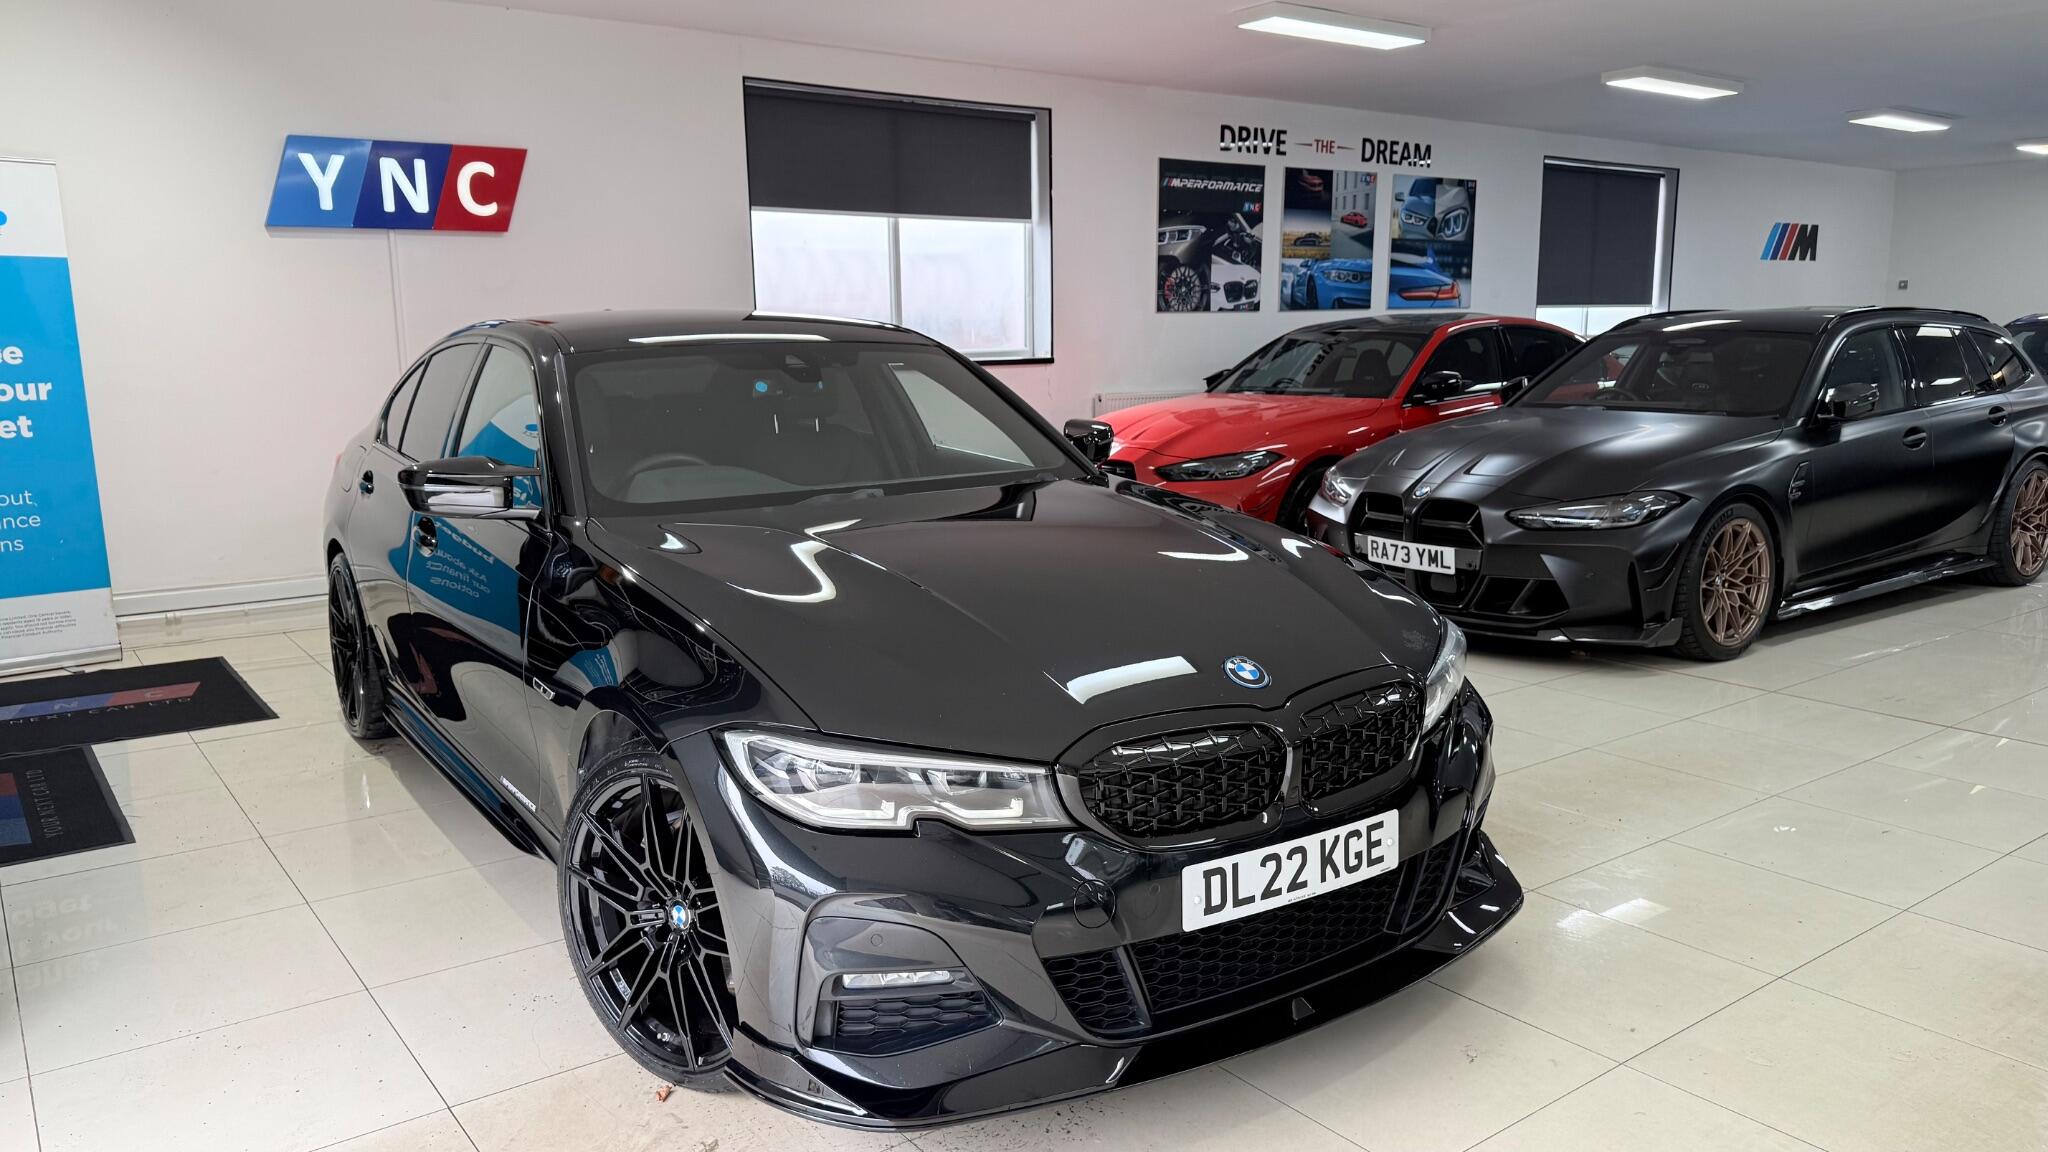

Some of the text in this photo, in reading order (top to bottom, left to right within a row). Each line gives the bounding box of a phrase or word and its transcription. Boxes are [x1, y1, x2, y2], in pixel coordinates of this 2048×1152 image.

[1219, 124, 1432, 168] DRIVE THE DREAM
[298, 153, 498, 217] YNC
[1787, 224, 1819, 261] M
[0, 345, 24, 365] e
[0, 515, 41, 529] nce
[1370, 540, 1452, 570] RA73 YML
[1203, 820, 1385, 917] DL22 KGE
